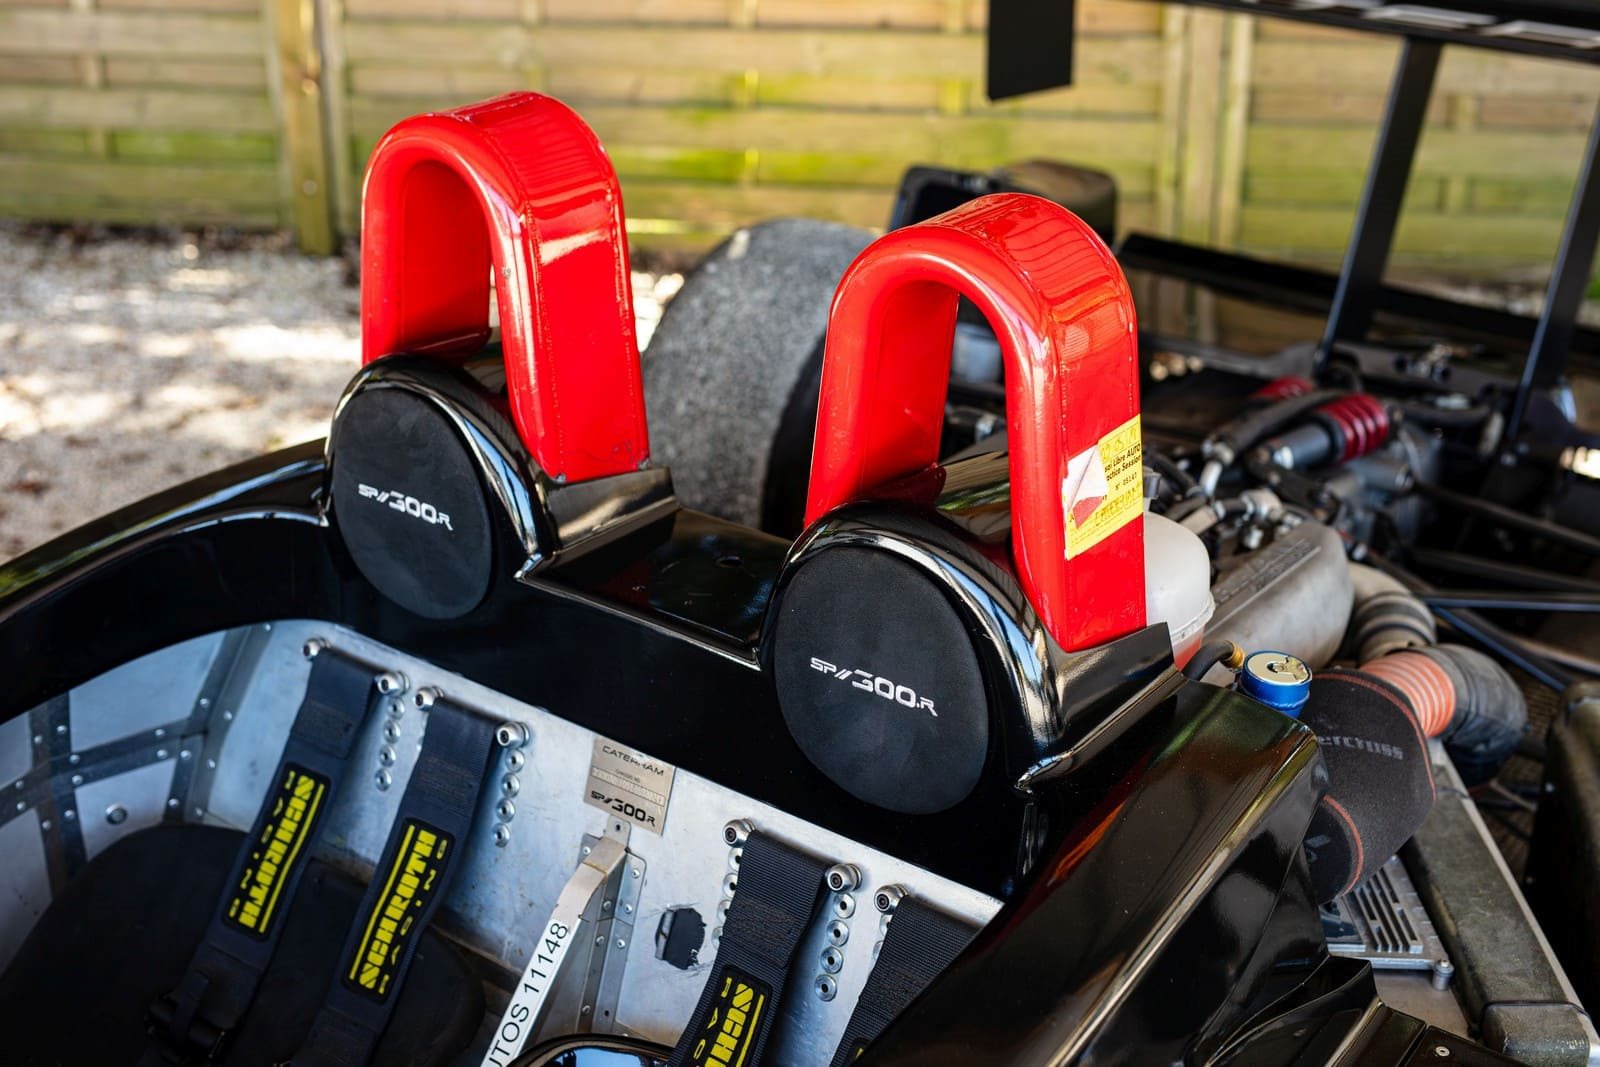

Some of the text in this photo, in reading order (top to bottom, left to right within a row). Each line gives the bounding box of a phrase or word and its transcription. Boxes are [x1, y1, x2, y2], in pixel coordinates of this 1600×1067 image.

[601, 745, 665, 777] CATERHAM
[238, 775, 315, 929] SCHROTH
[359, 829, 437, 989] SCHROTH
[523, 922, 569, 993] 11148
